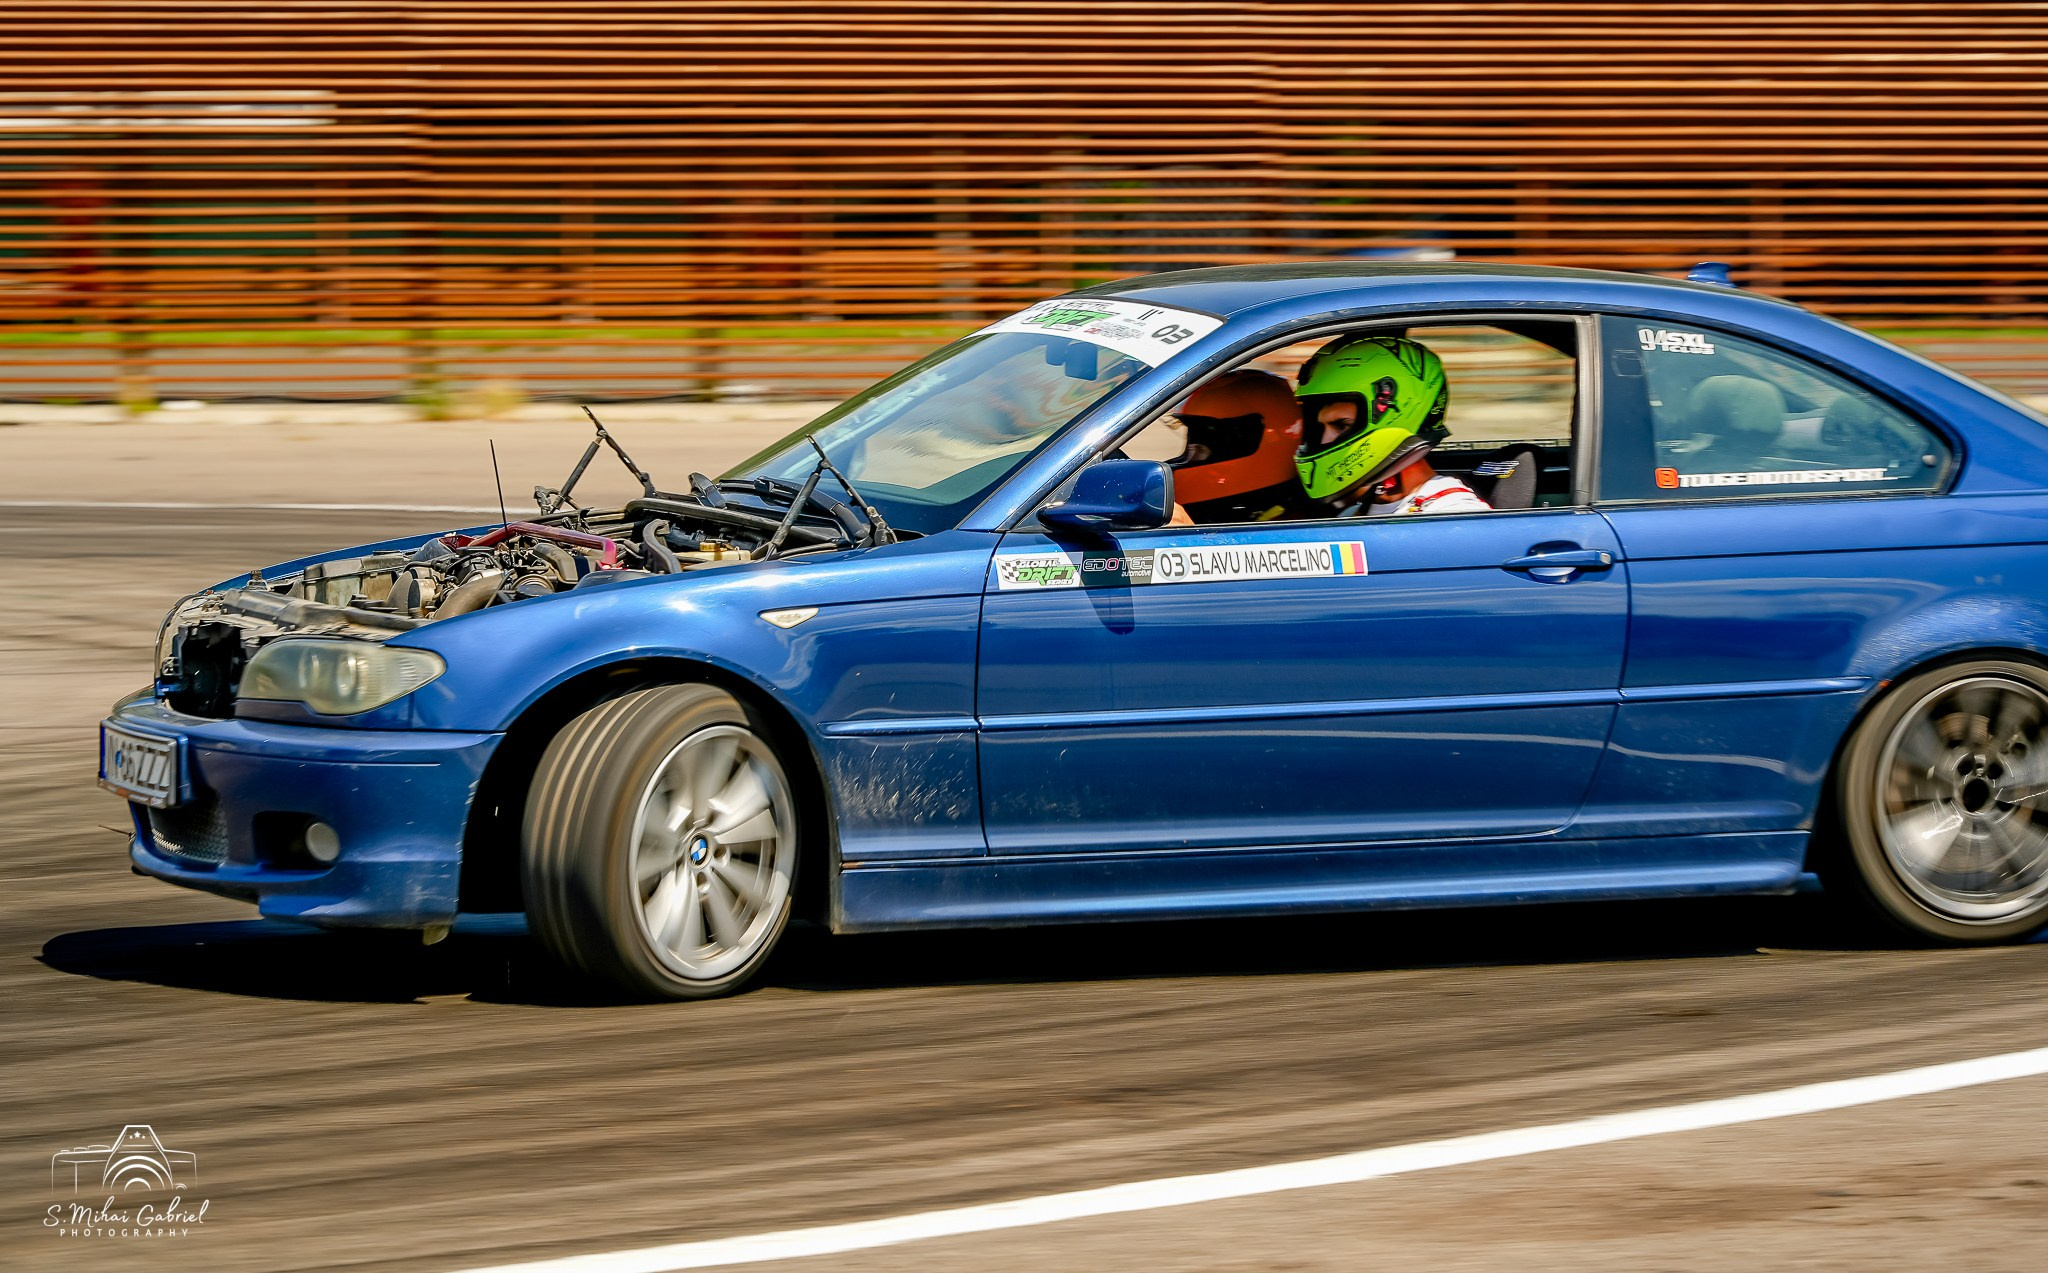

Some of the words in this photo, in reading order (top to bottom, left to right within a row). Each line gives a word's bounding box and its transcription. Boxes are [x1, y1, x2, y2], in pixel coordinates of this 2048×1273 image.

[1151, 324, 1194, 345] 03
[1019, 558, 1061, 568] GLOBAL
[1083, 556, 1154, 572] EDOTEC
[1159, 553, 1186, 577] 03
[1189, 551, 1240, 575] SLAVU
[1243, 548, 1331, 574] MARCELINO
[1017, 565, 1080, 586] DRIFT
[1121, 570, 1152, 578] automotive
